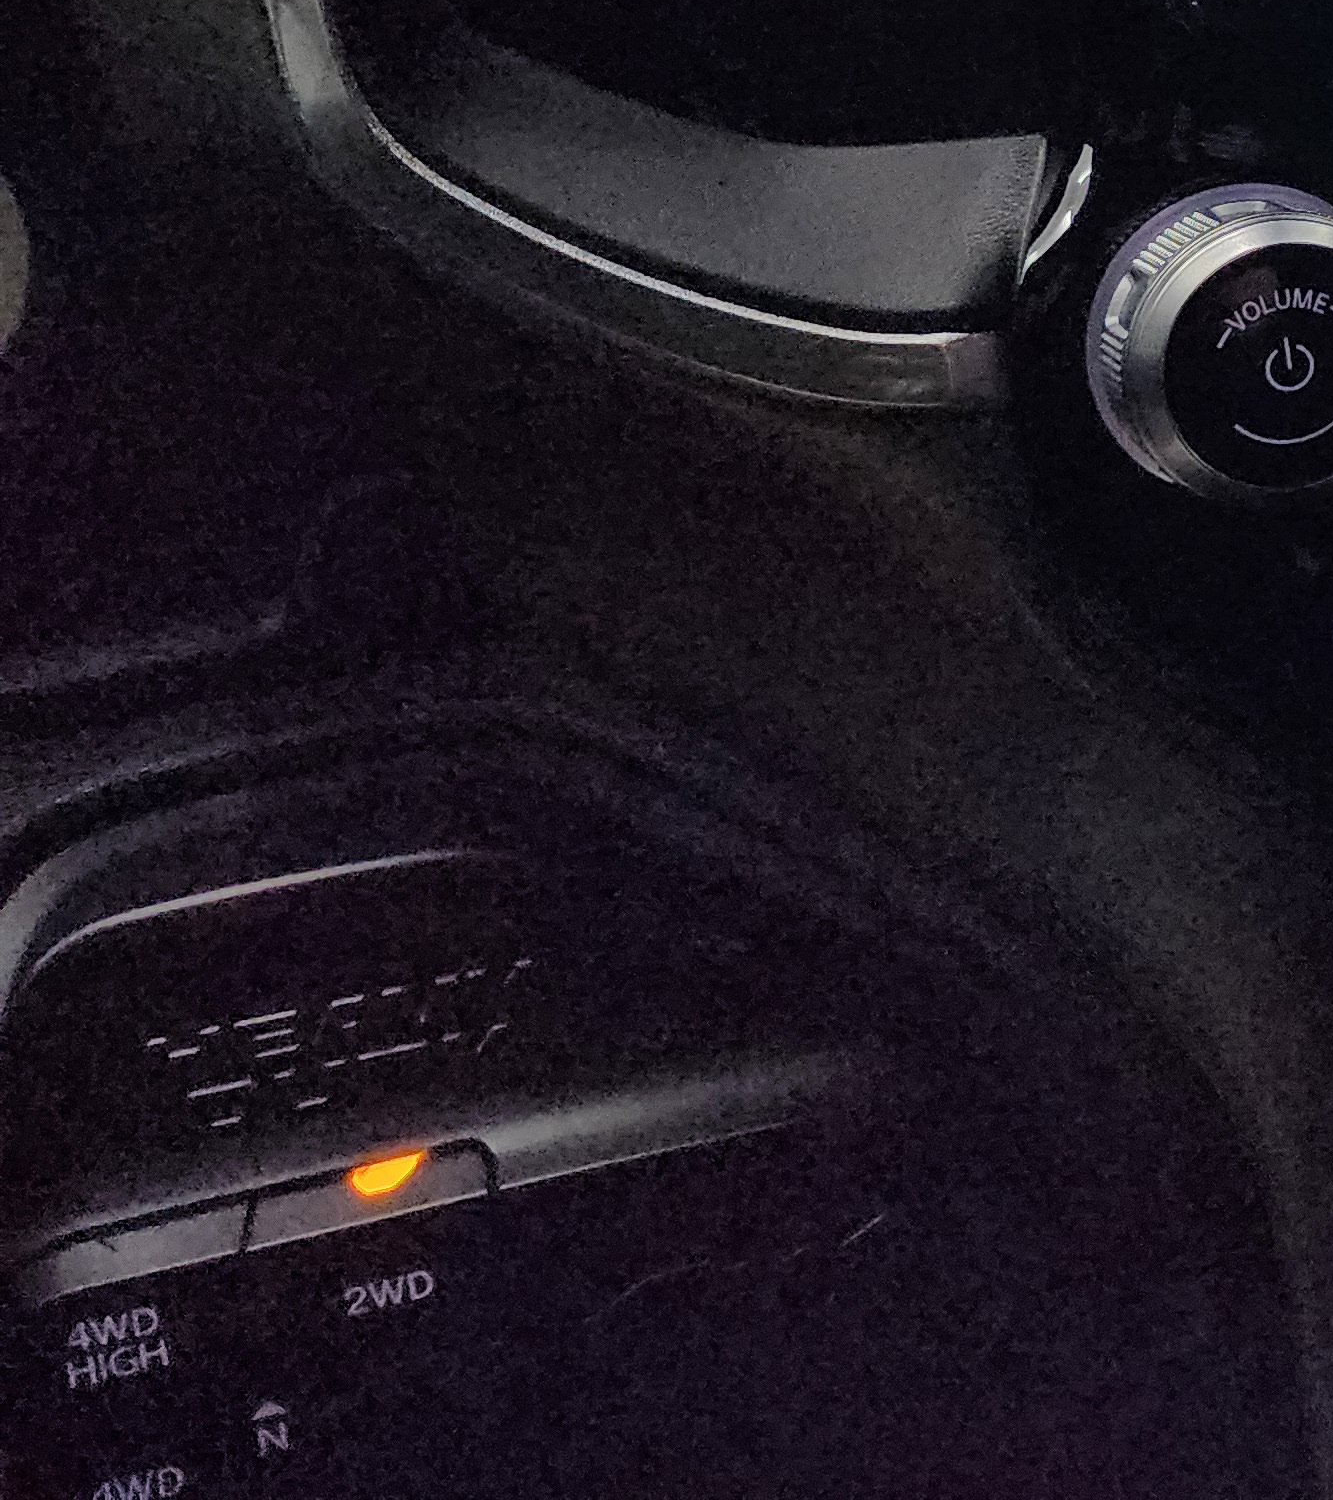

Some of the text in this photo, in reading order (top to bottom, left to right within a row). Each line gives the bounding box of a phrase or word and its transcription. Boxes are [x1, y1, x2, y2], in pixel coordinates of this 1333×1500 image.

[1223, 287, 1331, 332] VOLUME
[343, 1269, 436, 1318] 2WD
[68, 1307, 159, 1349] 4WD
[65, 1338, 170, 1388] HIGH
[256, 1419, 288, 1457] N
